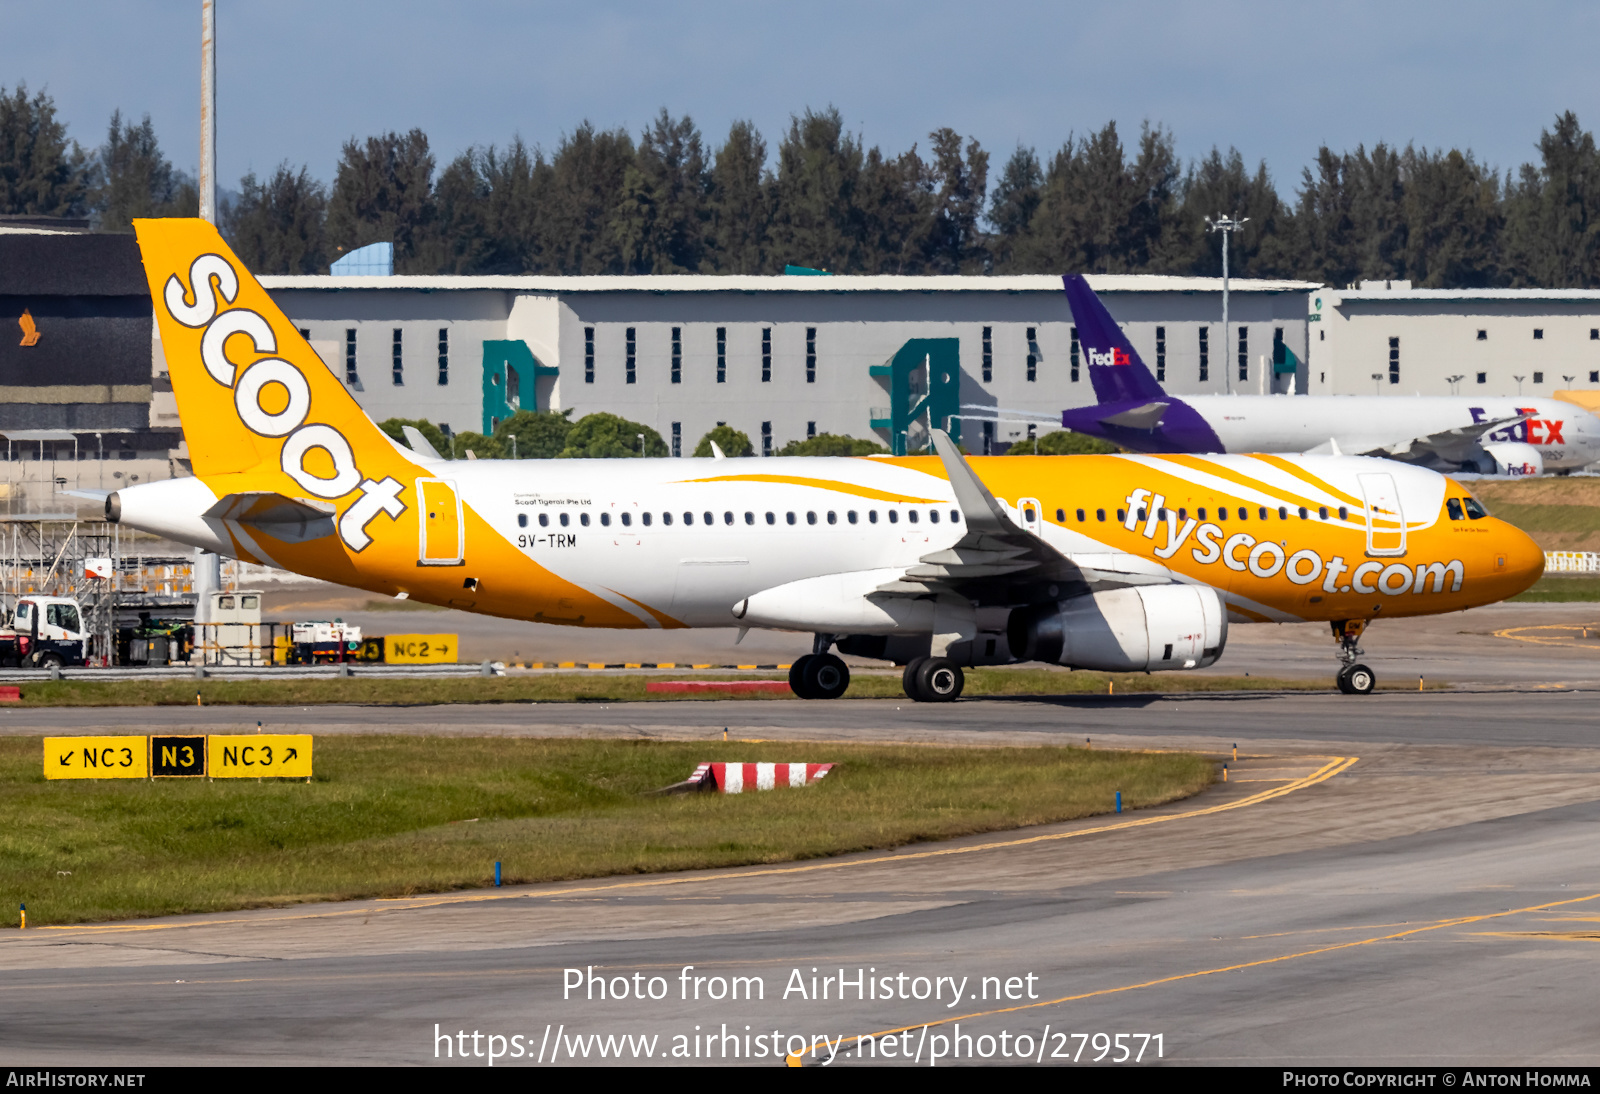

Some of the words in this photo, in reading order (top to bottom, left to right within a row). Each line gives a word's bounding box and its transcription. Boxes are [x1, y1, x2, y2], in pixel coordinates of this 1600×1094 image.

[1088, 347, 1130, 366] FedEx
[164, 253, 407, 552] scoot
[1508, 463, 1537, 476] FedEx
[518, 534, 576, 548] 9V-TRM
[1123, 487, 1466, 596] flyscoot.com
[394, 642, 429, 657] NC2
[83, 747, 133, 768] NC3
[161, 745, 195, 768] N3
[223, 745, 273, 766] NC3
